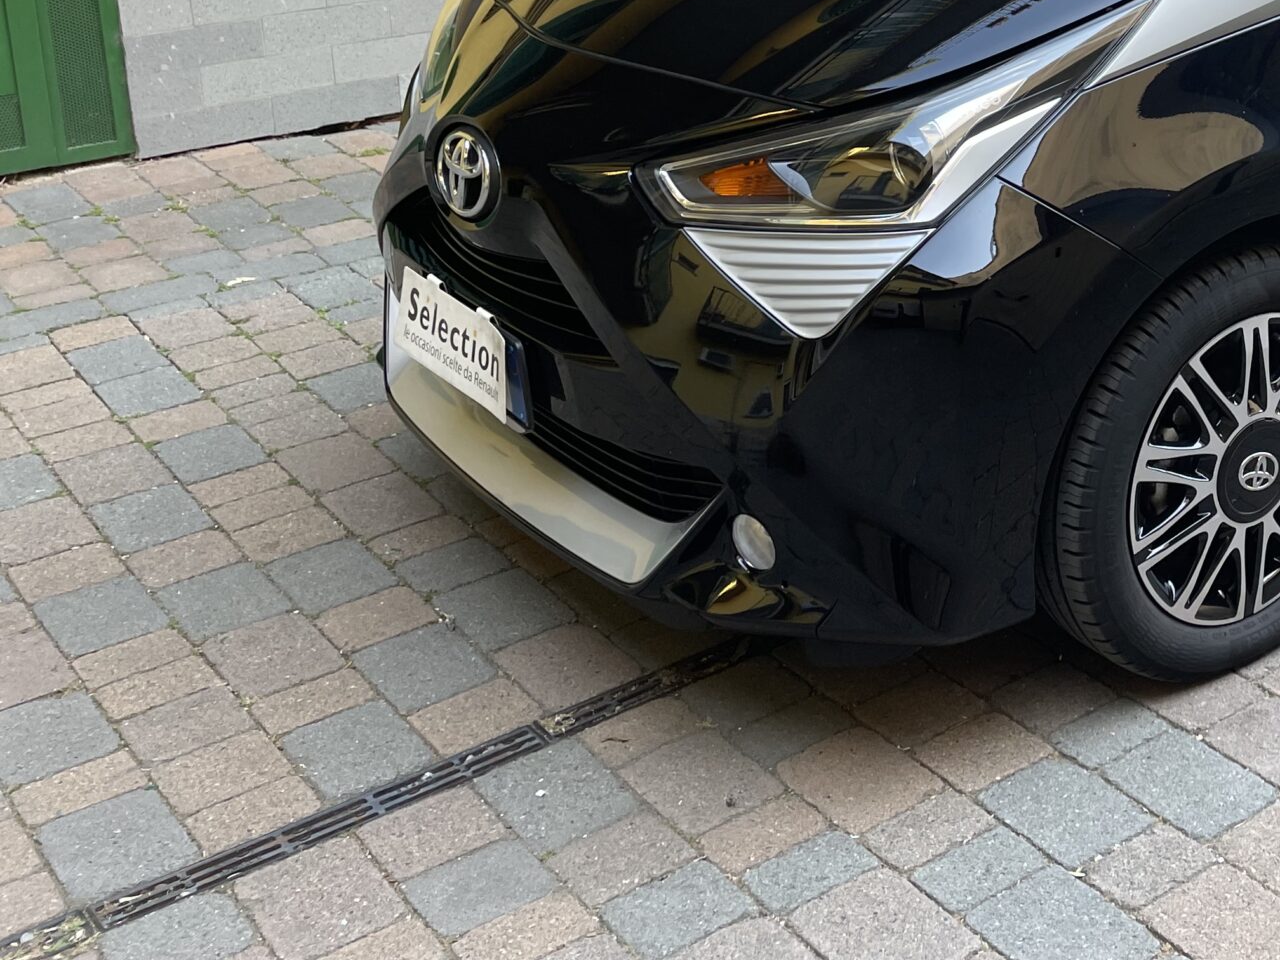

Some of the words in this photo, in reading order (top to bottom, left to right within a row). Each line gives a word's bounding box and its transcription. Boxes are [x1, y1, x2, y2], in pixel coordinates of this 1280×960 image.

[403, 323, 411, 339] le
[411, 332, 442, 360] occasioni
[442, 353, 463, 375] scelte
[463, 365, 473, 382] da
[474, 371, 499, 402] Renault
